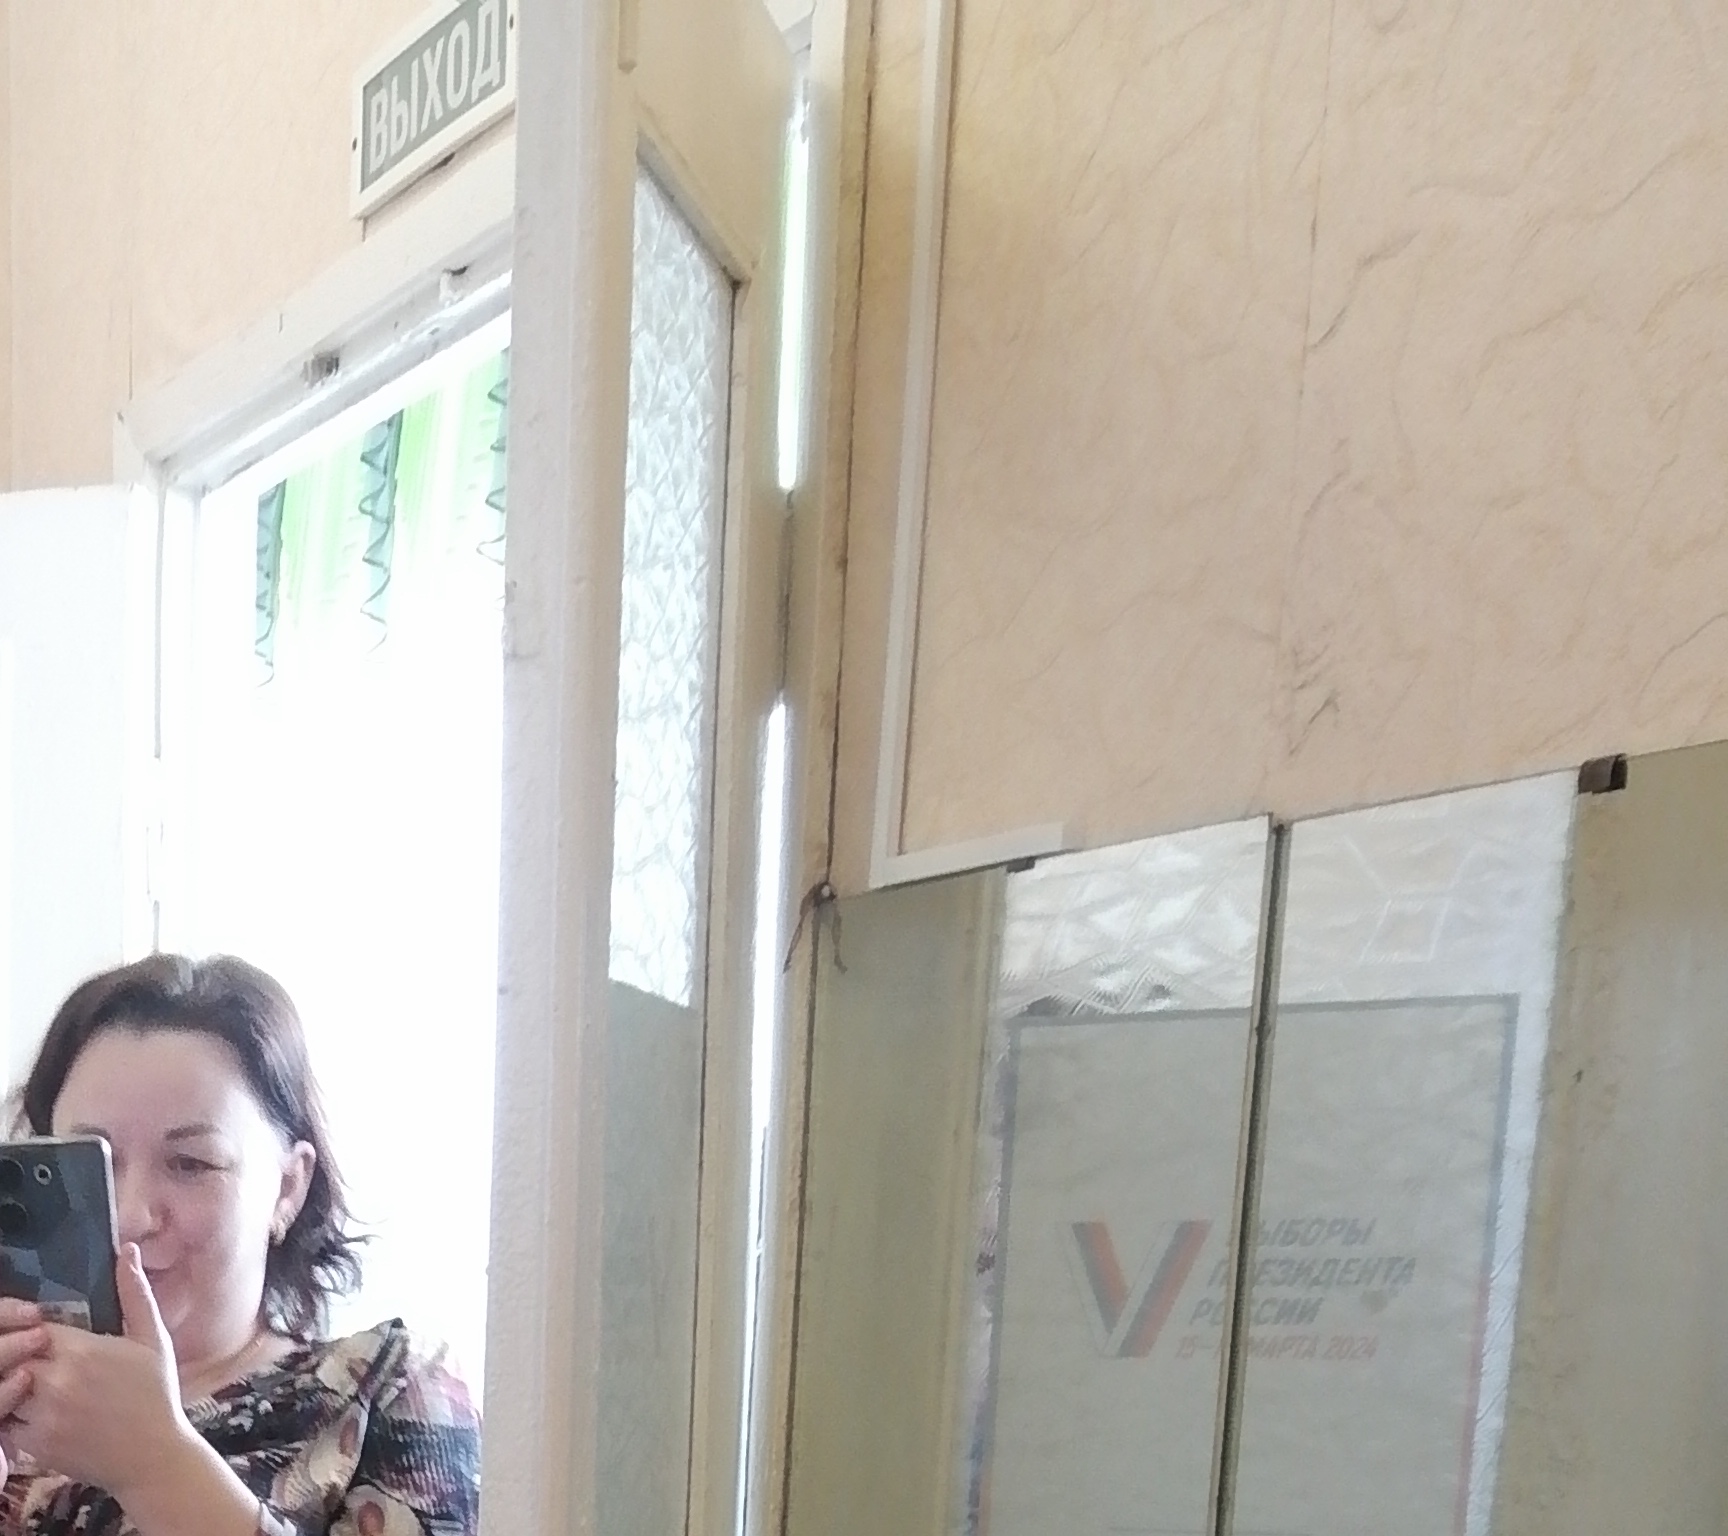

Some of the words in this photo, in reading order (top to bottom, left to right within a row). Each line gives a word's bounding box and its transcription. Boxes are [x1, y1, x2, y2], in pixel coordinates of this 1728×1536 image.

[370, 0, 501, 174] ВЫХОД
[1229, 1217, 1378, 1248] ЫБОРЫ
[1207, 1256, 1417, 1290] ПЕЗИДЕНТА
